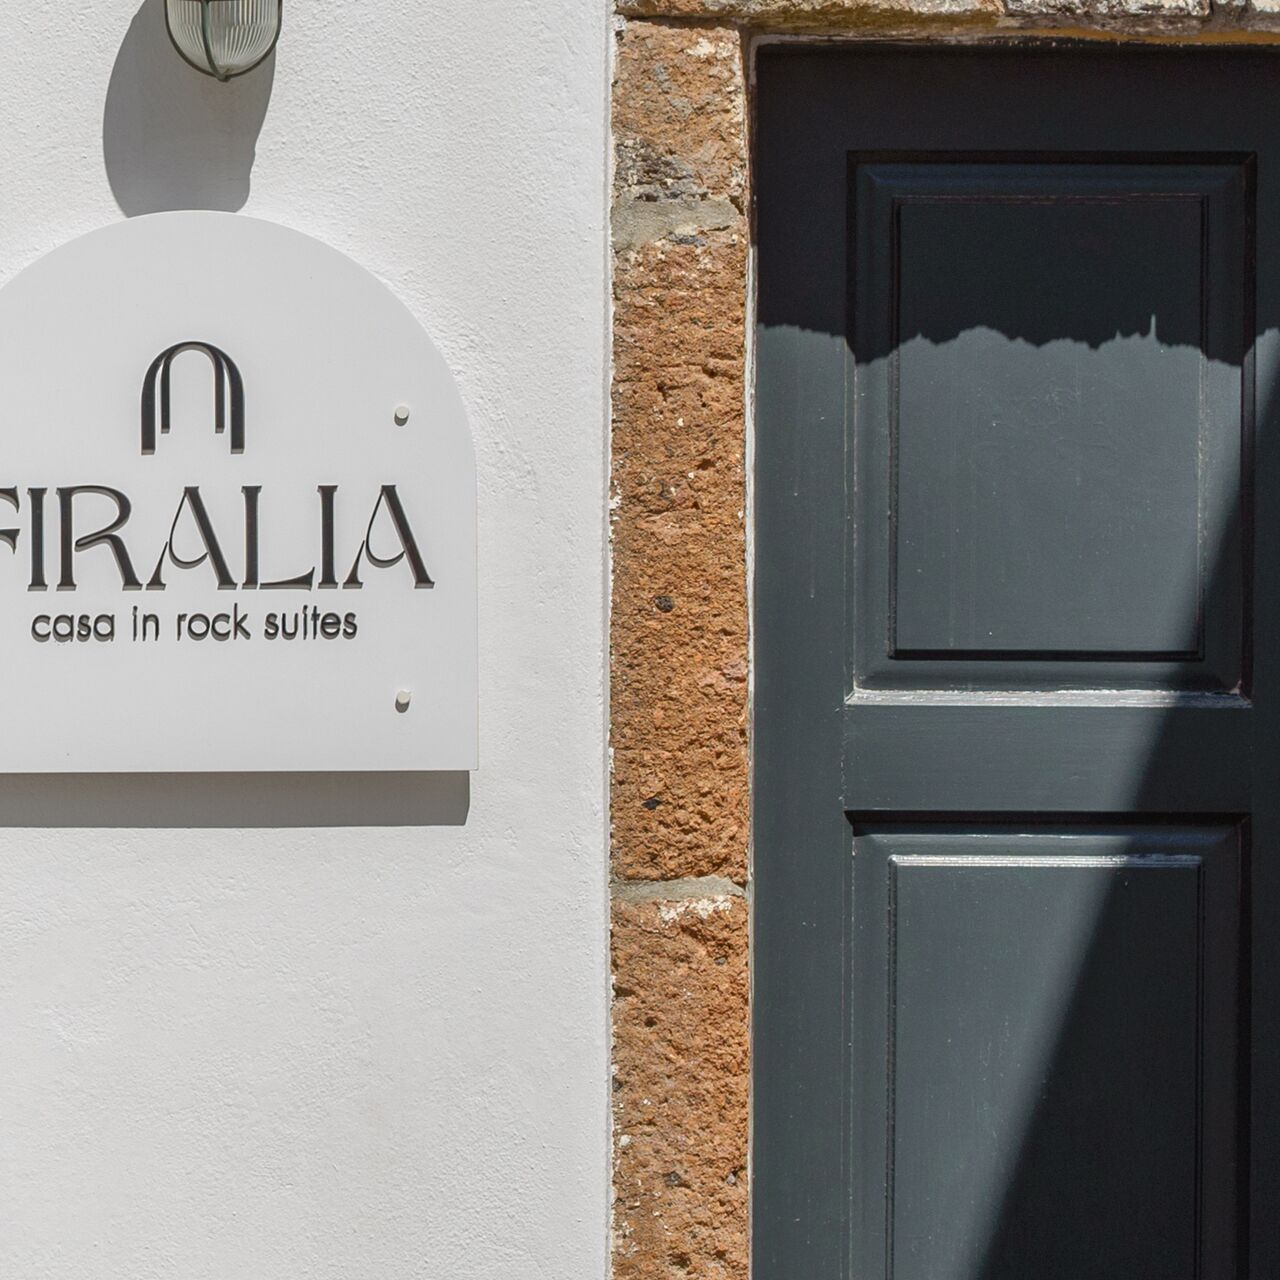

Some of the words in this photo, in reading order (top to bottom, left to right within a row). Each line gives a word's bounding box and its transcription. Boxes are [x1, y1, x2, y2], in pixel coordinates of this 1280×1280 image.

[31, 611, 116, 643] casa
[131, 604, 161, 642] in
[176, 603, 252, 642] rock
[263, 604, 359, 642] suites
